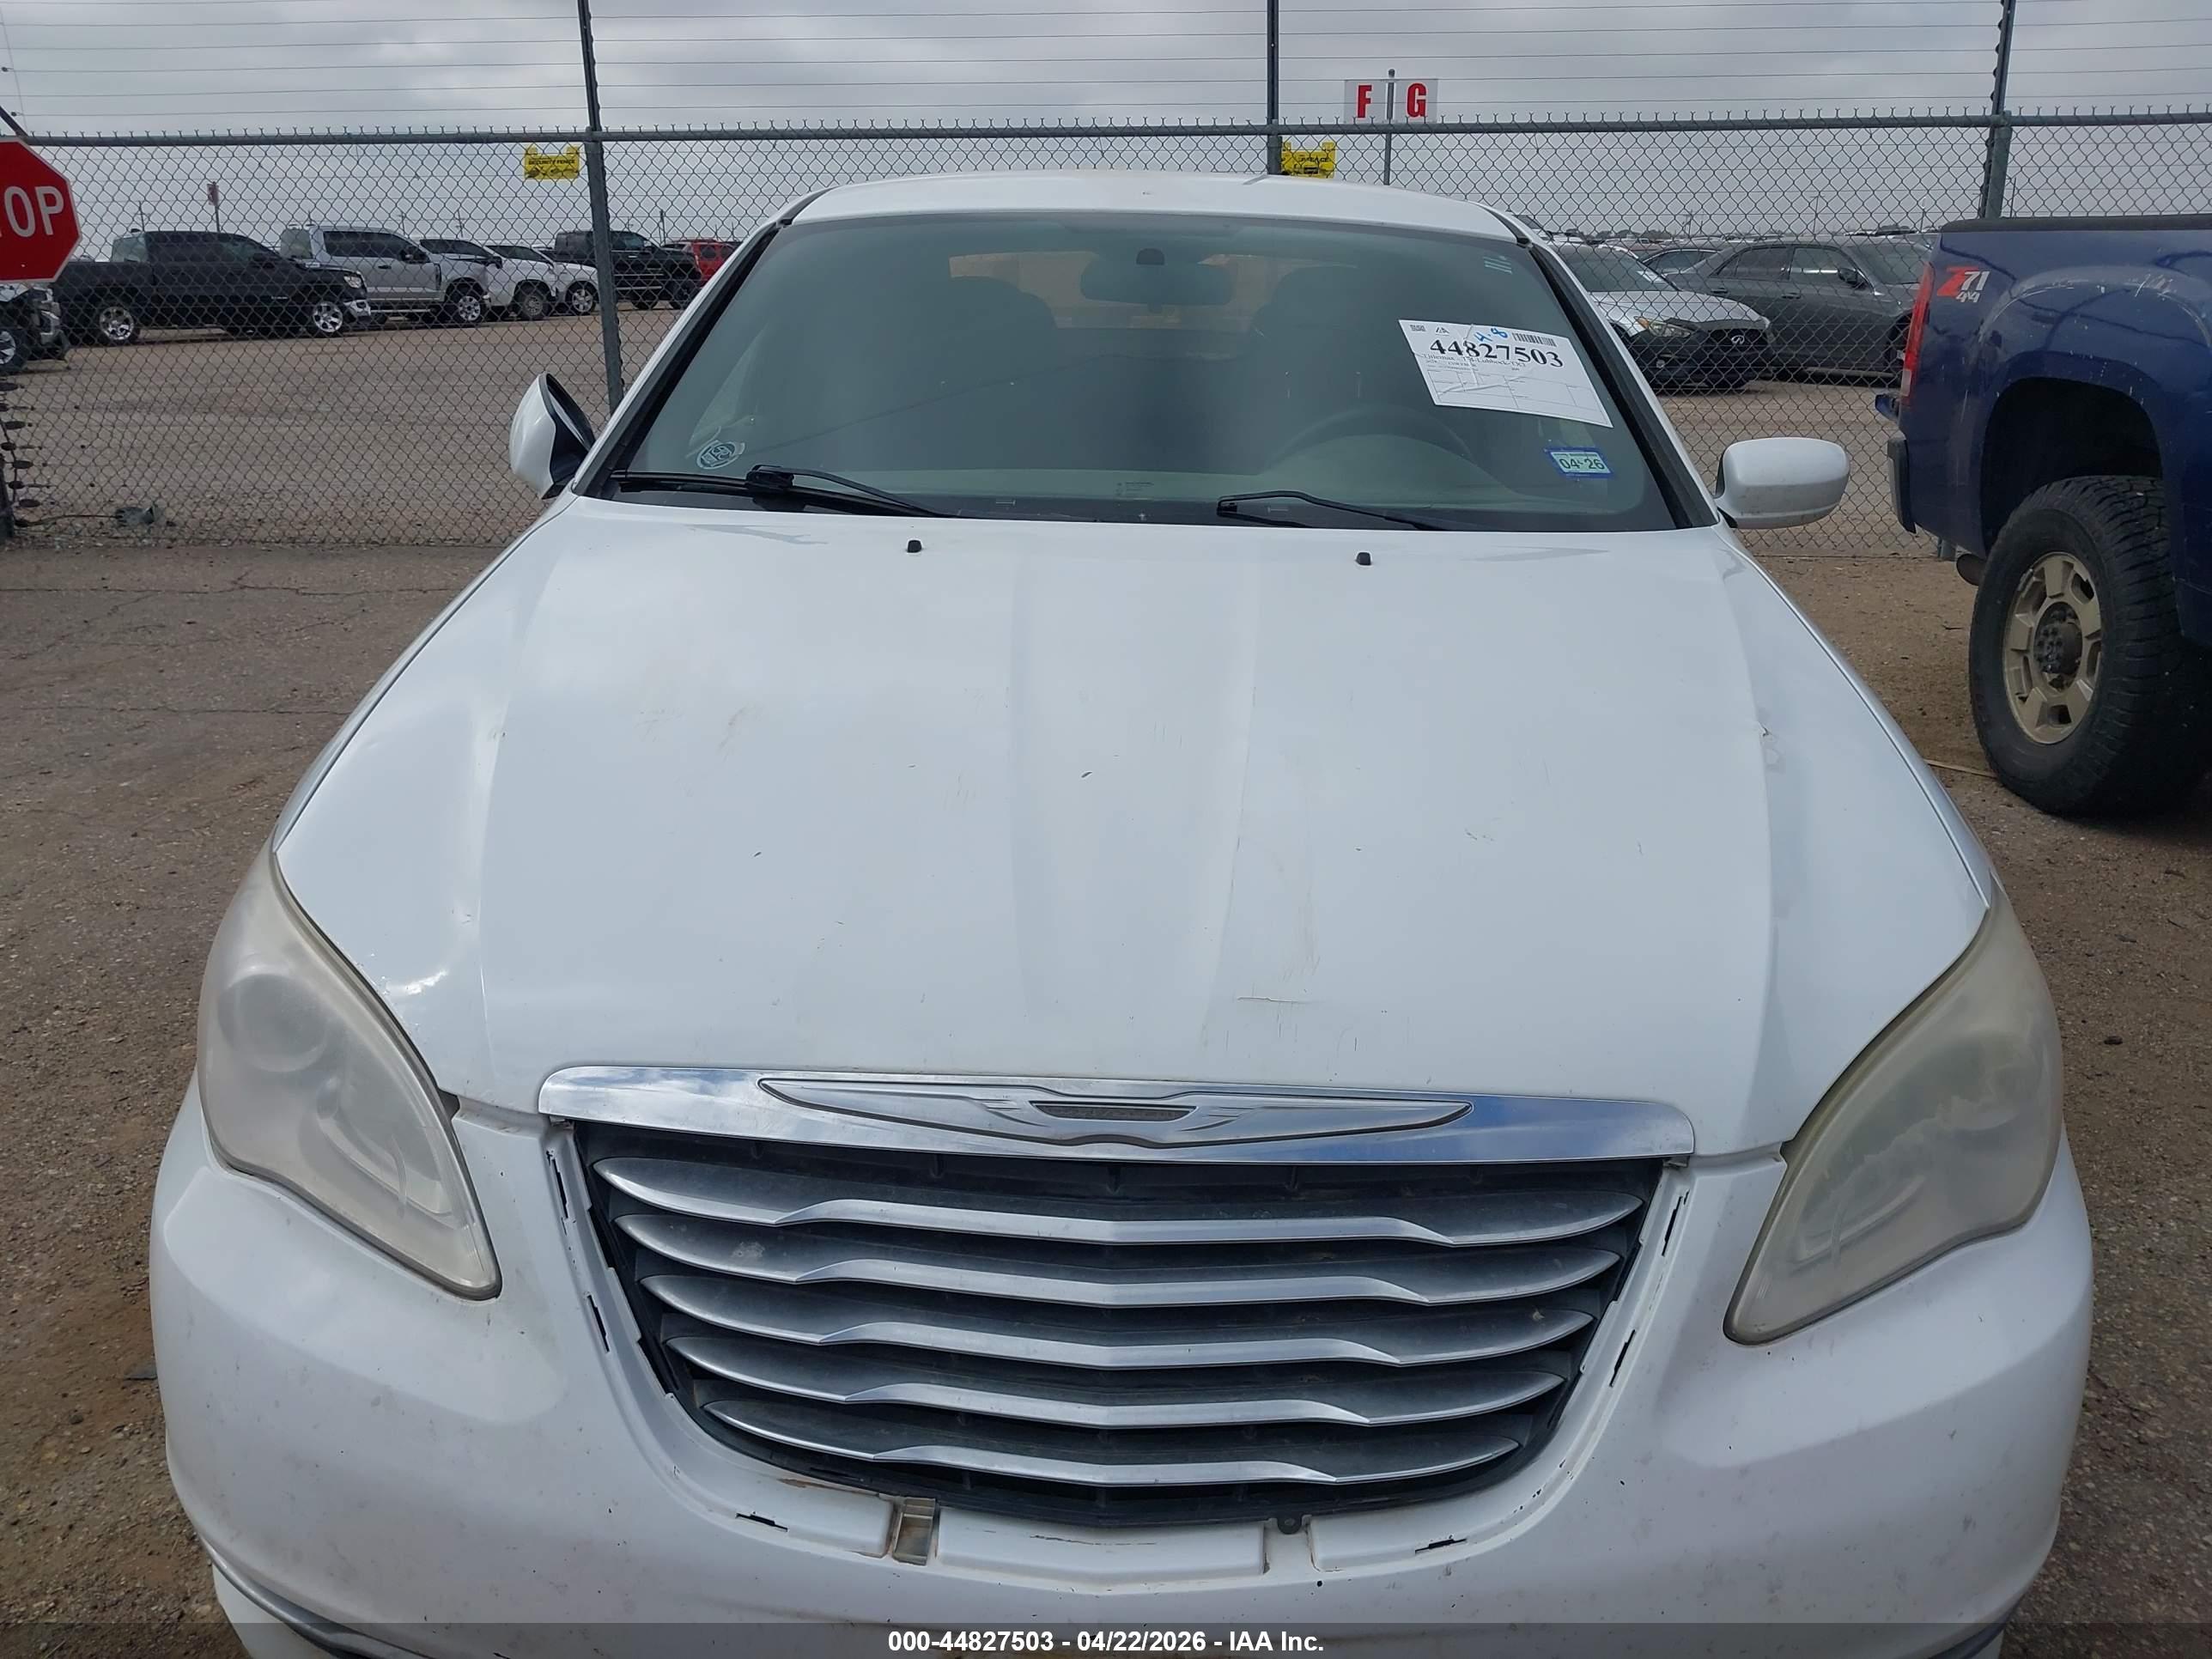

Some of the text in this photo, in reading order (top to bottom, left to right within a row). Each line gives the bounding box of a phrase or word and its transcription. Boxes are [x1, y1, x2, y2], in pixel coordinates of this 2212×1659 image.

[1357, 84, 1373, 118] F
[1407, 82, 1428, 118] G
[0, 185, 64, 238] OP
[1937, 265, 1991, 296] Z71
[1430, 339, 1564, 368] 44827503
